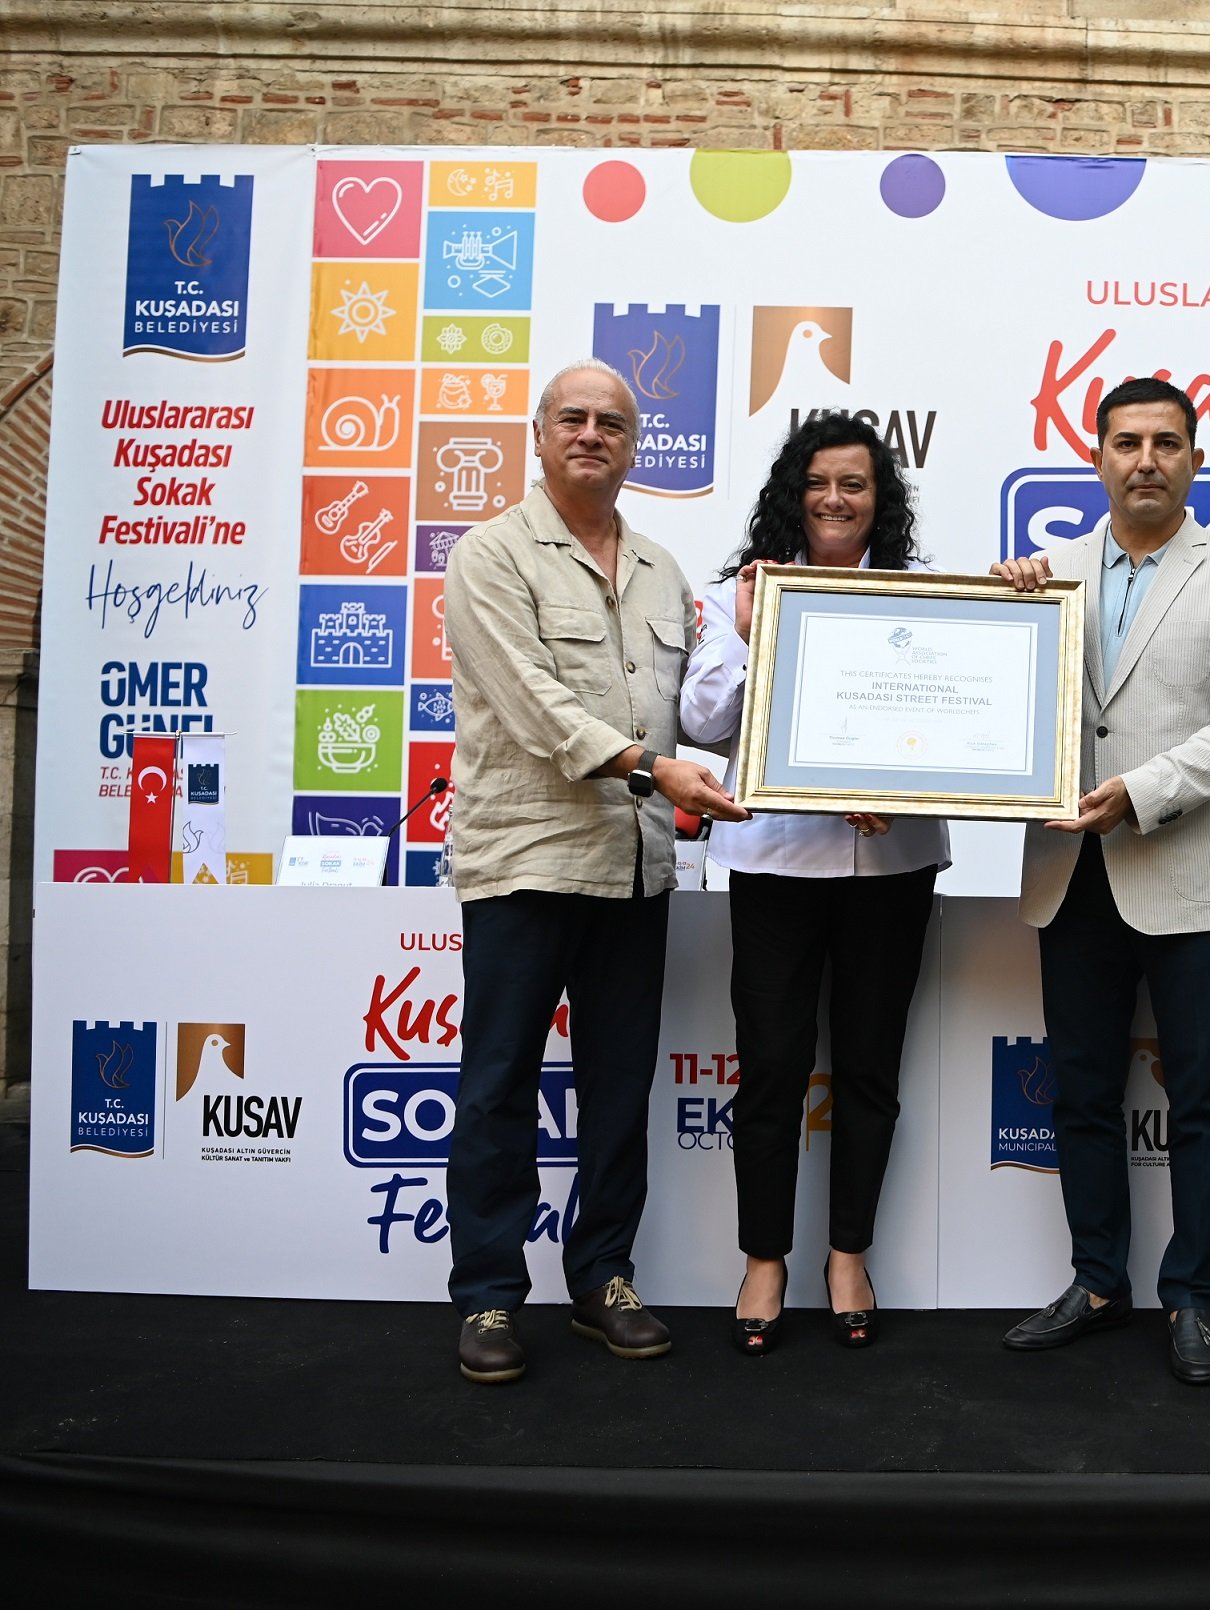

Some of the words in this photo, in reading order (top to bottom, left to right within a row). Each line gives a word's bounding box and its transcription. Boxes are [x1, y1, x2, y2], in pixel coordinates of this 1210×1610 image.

[174, 281, 203, 295] T.C.
[135, 300, 239, 318] KUŞADASI
[134, 320, 238, 334] BELEDİYESİ
[101, 400, 254, 429] Uluslararası
[640, 413, 670, 428] T.C.
[113, 438, 233, 472] Kuşadası
[133, 477, 216, 506] Sokak
[859, 671, 912, 680] CERTIFICATES
[913, 673, 942, 681] HEREBY
[945, 675, 993, 684] RECOGNISES
[871, 681, 959, 694] INTERNATIONAL
[836, 691, 893, 702] KUSADASI
[896, 694, 939, 704] STREET
[941, 696, 993, 706] FESTIVAL
[99, 767, 122, 780] T.C.
[105, 1098, 124, 1109] T.C.
[78, 1111, 149, 1126] KUŞADASI
[202, 1094, 303, 1139] KUSAV
[77, 1126, 149, 1138] BELEDİYESİ
[257, 1147, 291, 1155] GÜVERCİN
